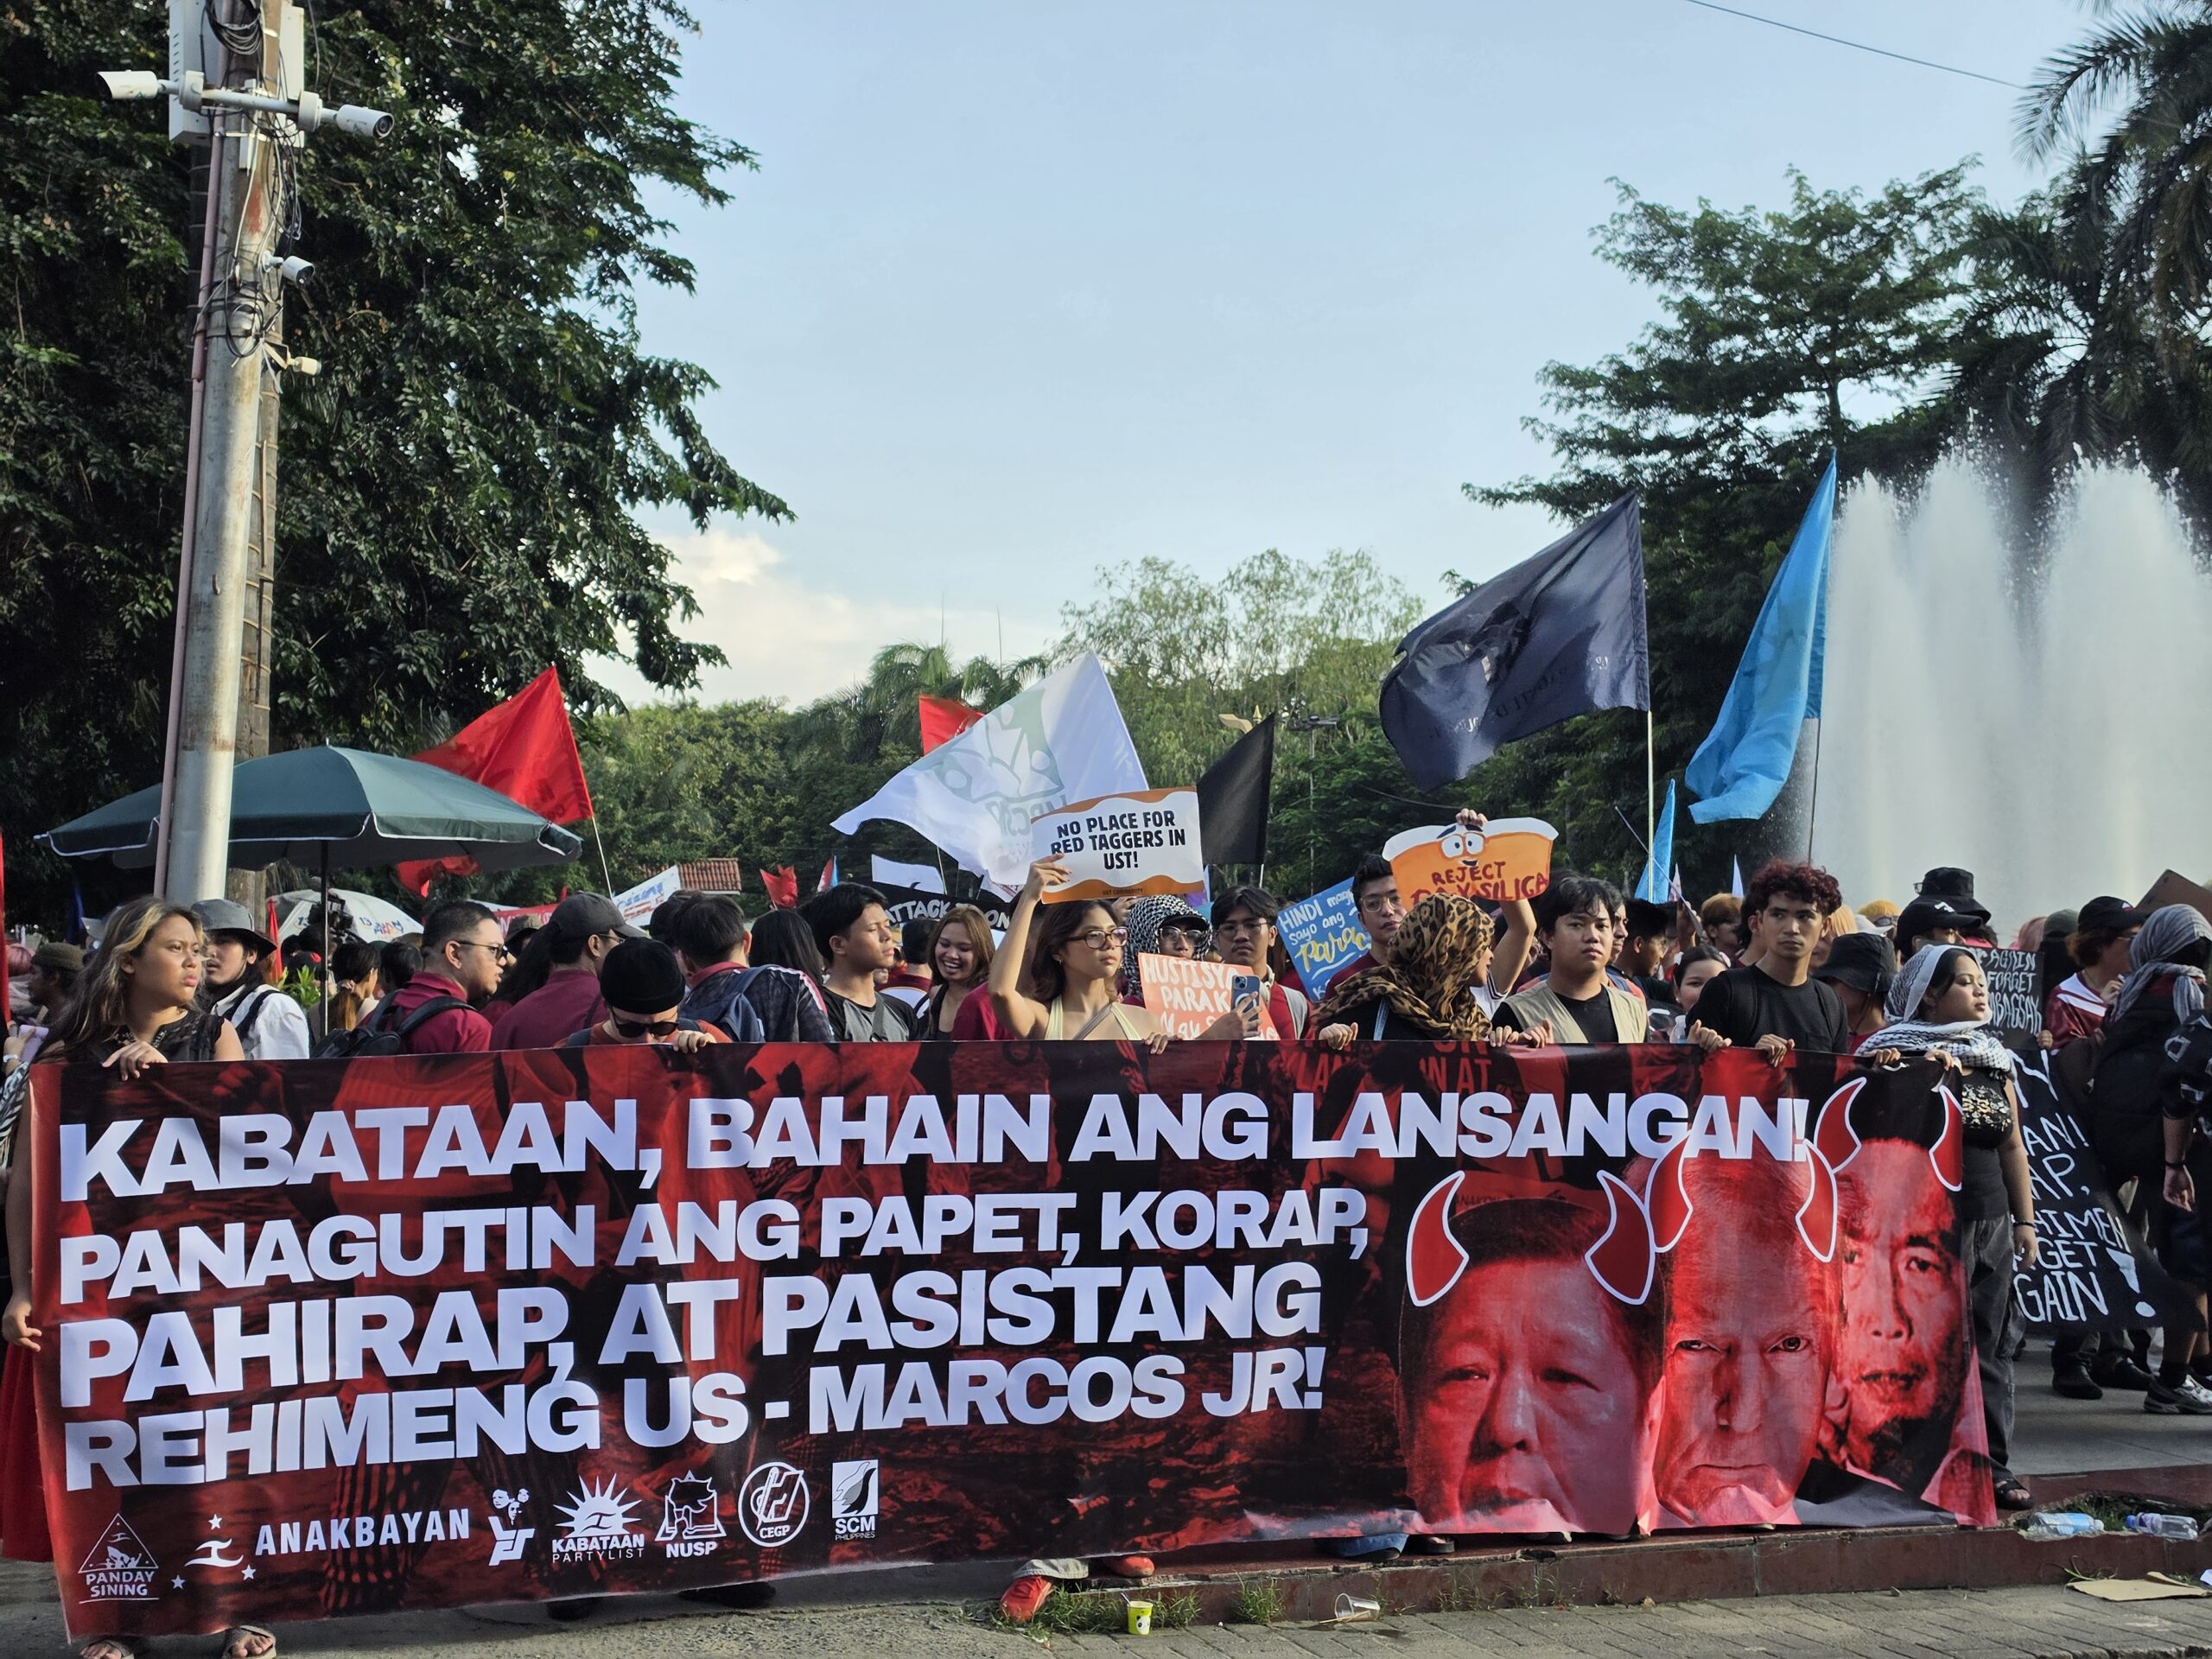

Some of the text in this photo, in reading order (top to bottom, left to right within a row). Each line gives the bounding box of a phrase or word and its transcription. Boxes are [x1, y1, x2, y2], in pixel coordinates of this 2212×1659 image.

[1057, 810, 1175, 838] NO PLACE FOR
[1051, 837, 1084, 855] RED
[1089, 830, 1164, 850] TAGGERS
[1168, 829, 1185, 846] IN
[1103, 851, 1138, 869] UST!
[1431, 861, 1506, 886] REJECT
[1476, 872, 1548, 899] SILICA
[1278, 899, 1323, 933] HINDI
[1322, 912, 1345, 929] ang
[60, 1091, 1808, 1202] KABATAAN, BAHAIN ANG LANSANGAN!
[2022, 1112, 2089, 1156] AN!
[2029, 1154, 2090, 1200] AP,
[60, 1187, 1368, 1305] PANAGUTIN ANG PAPET, KORAP,
[60, 1262, 1322, 1408] PAHIRAP, AT PASISTANG
[65, 1379, 601, 1491] REHIMENG
[624, 1372, 749, 1447] US
[809, 1353, 1185, 1434] MARCOS
[1202, 1347, 1325, 1417] JR!
[255, 1508, 469, 1556] ANAKBAYAN
[759, 1525, 791, 1539] CEGP
[835, 1516, 876, 1535] SCM
[835, 1531, 876, 1541] PHILIPPINES
[552, 1534, 645, 1554] KABATAAN
[552, 1548, 645, 1563] PARTYLIST
[666, 1541, 718, 1558] NUSP
[86, 1571, 155, 1585] PANDAY
[90, 1583, 148, 1598] SINING
